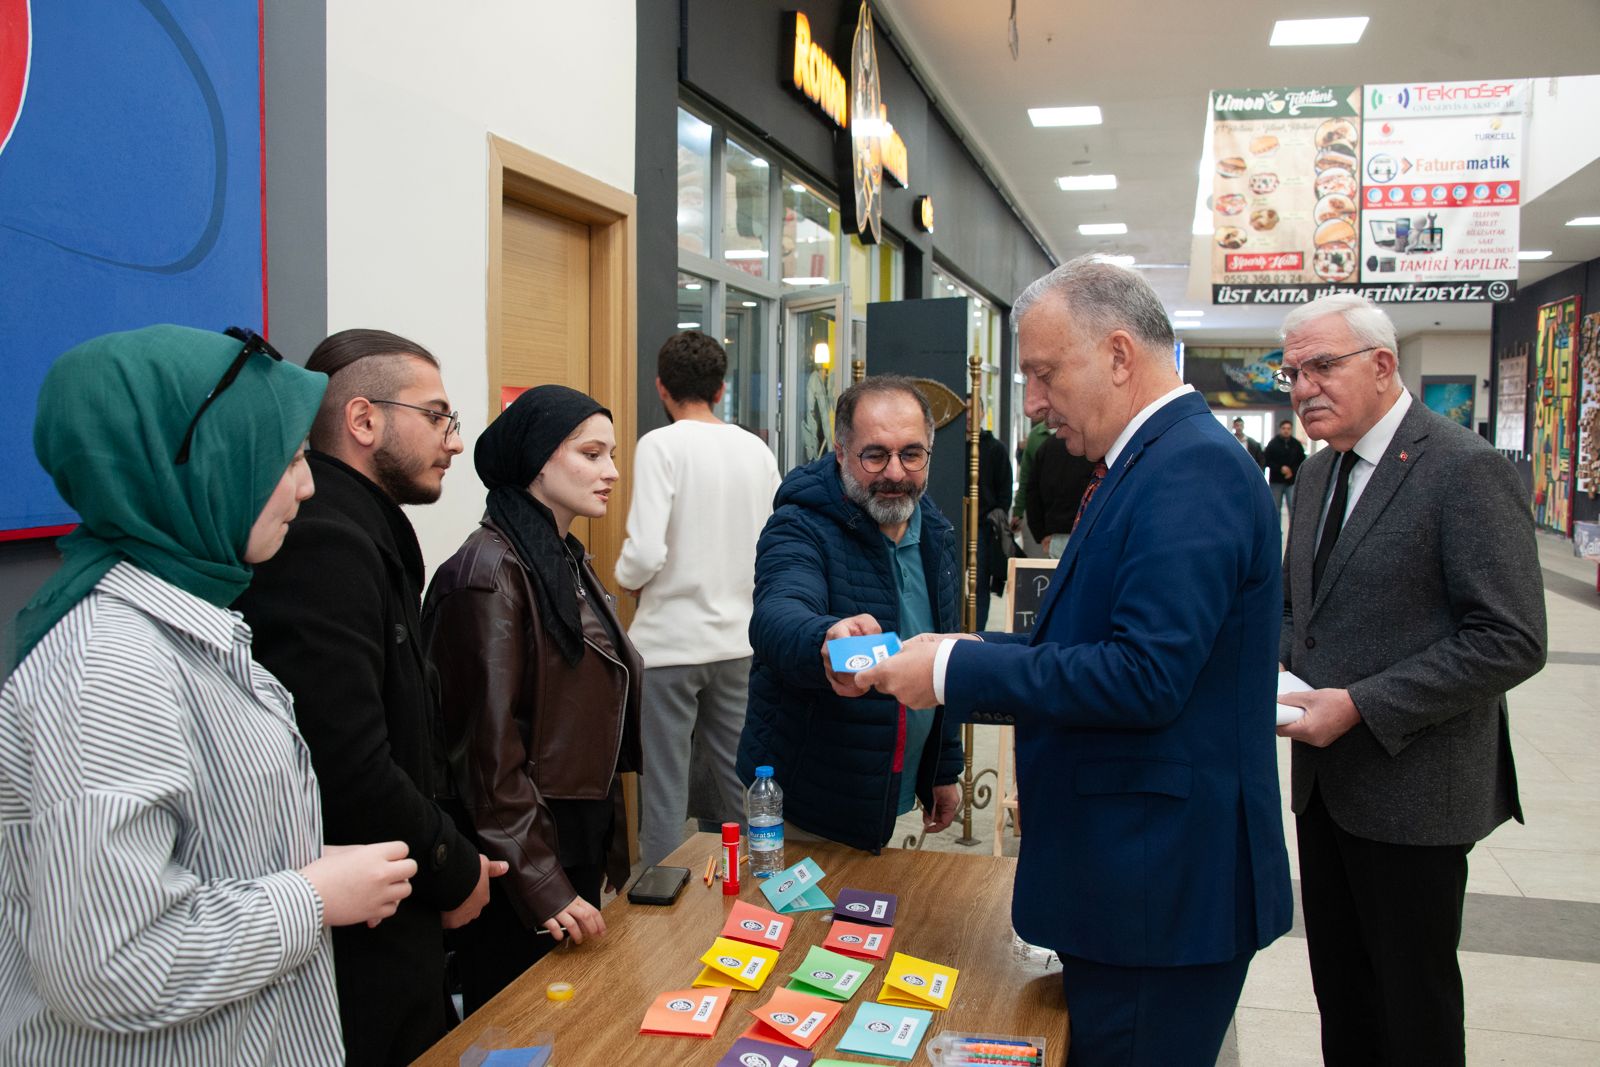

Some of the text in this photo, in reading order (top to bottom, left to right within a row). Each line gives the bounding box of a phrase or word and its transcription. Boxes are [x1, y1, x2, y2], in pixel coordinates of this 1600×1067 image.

[1215, 94, 1265, 111] Limon
[1415, 155, 1510, 172] Faturamatik
[1400, 256, 1448, 272] TAMİRİ
[1217, 286, 1252, 303] ÜST
[1253, 288, 1309, 303] KATTA
